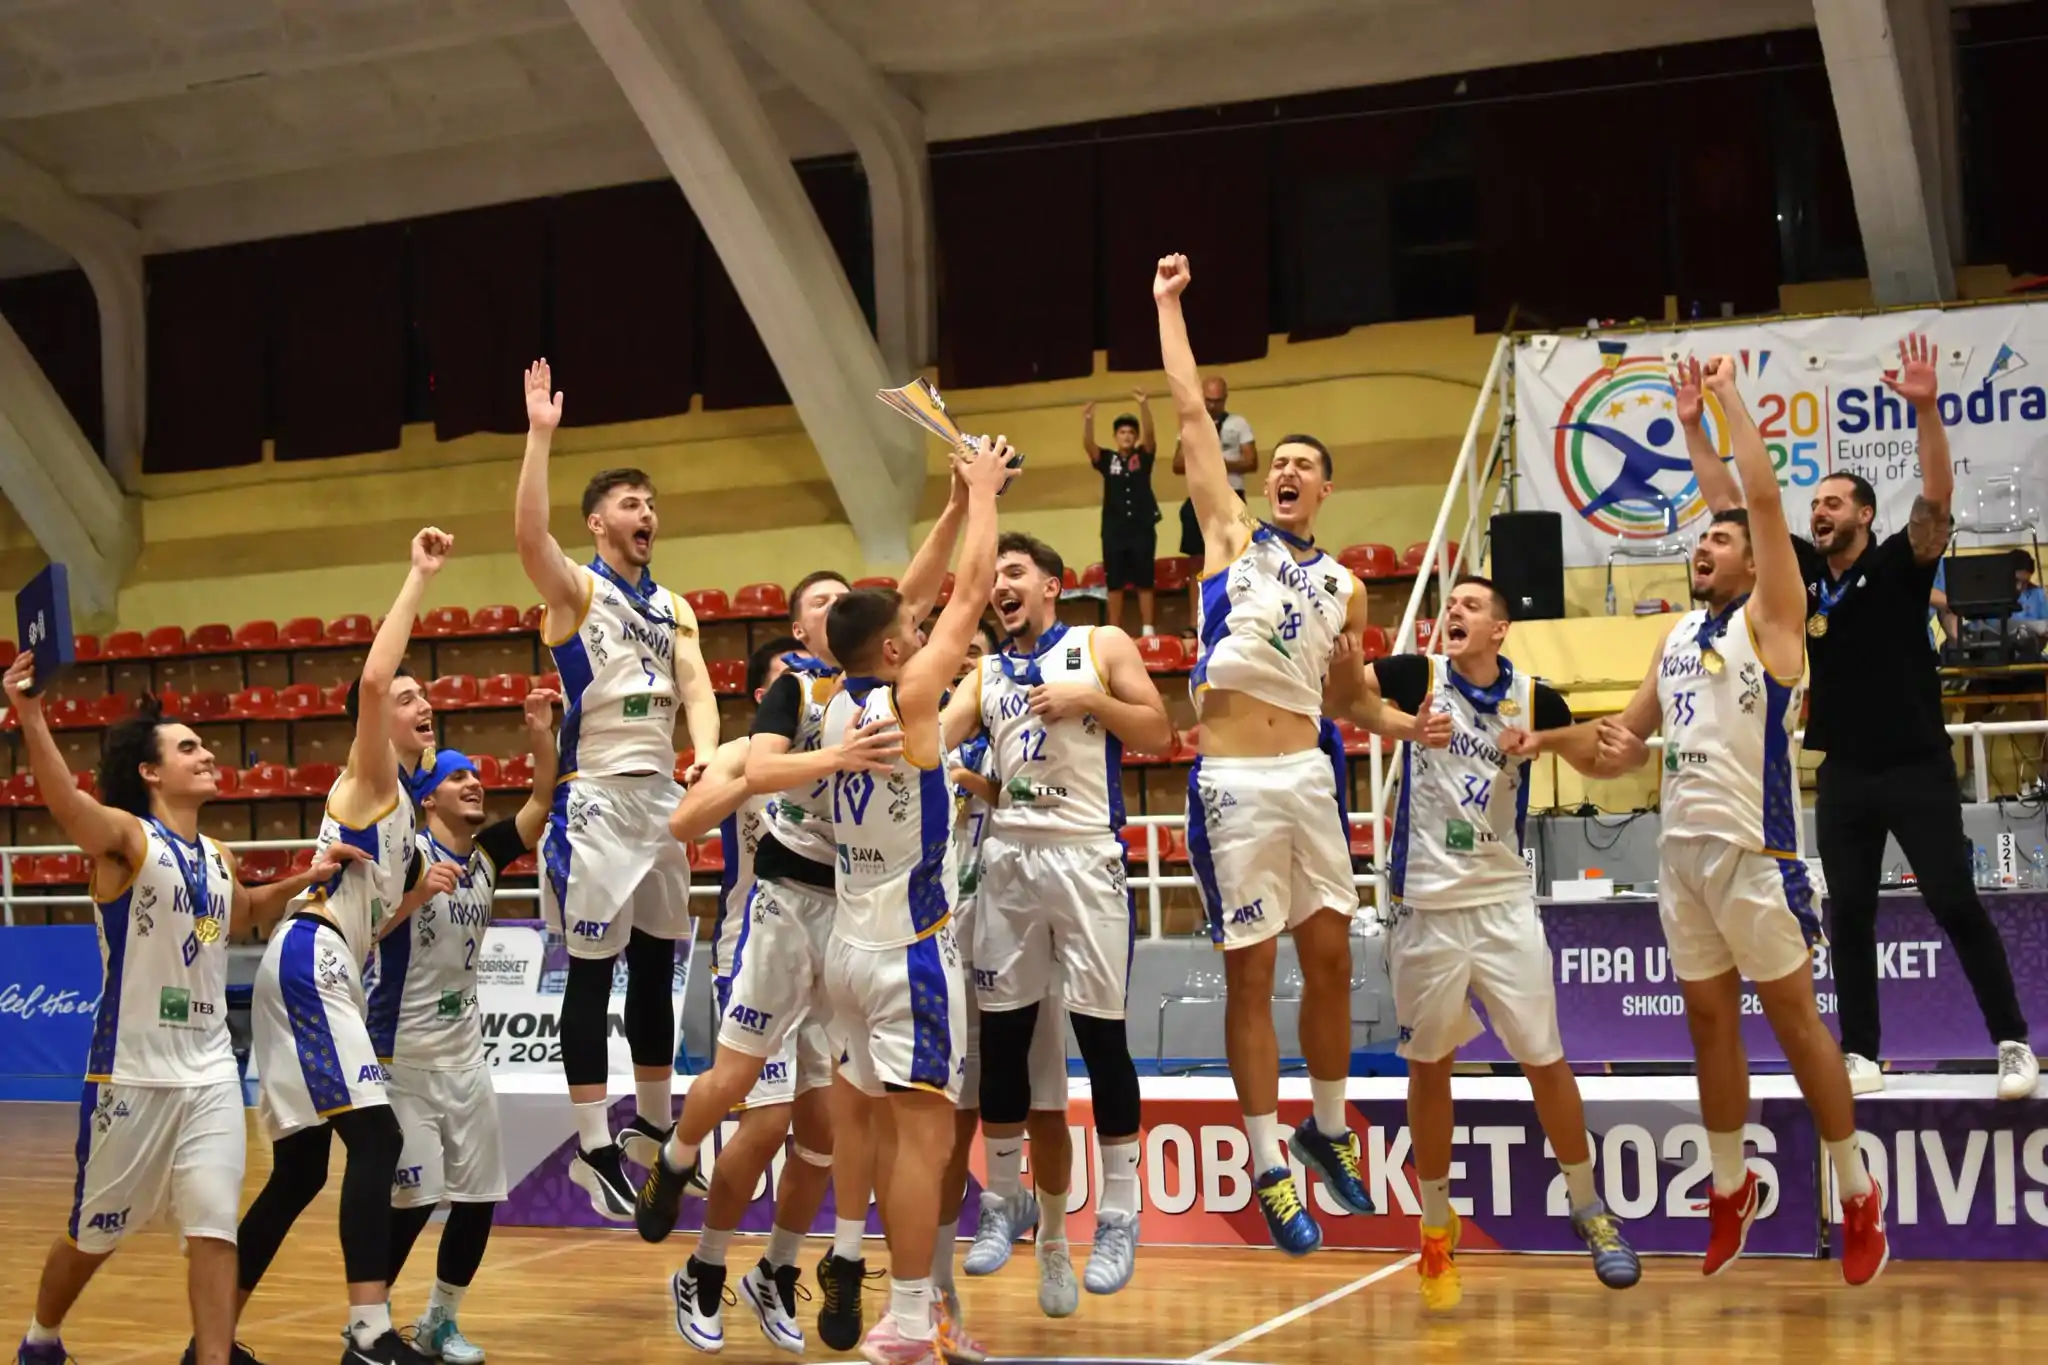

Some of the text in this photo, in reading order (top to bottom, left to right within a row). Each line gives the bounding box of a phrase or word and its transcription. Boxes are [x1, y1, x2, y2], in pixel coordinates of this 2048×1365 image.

[1758, 391, 1820, 438] 20
[1838, 439, 1920, 462] Europe
[1886, 459, 1908, 480] of
[1913, 456, 1971, 478] srt
[1277, 602, 1302, 640] 18
[641, 657, 656, 687] 5
[1661, 655, 1706, 678] KOSOV
[1673, 691, 1696, 726] 35
[1020, 729, 1048, 762] 12
[1679, 752, 1708, 763] TEB
[1036, 786, 1068, 797] TEB
[1460, 773, 1491, 812] 34
[2002, 834, 2011, 847] 3
[852, 847, 885, 863] SAVA
[2003, 848, 2011, 860] 2
[2004, 861, 2010, 873] 1
[173, 885, 226, 920] KOVA
[1231, 899, 1265, 924] ART
[573, 919, 611, 938] ART
[465, 938, 476, 971] 2
[1561, 946, 1678, 984] FIBA U
[478, 959, 529, 974] ROBASKET
[976, 969, 998, 987] RT
[191, 1001, 215, 1015] TEB
[1622, 994, 1764, 1016] SHKOD 26
[481, 1013, 627, 1039] WOMN
[729, 1004, 773, 1030] ART
[509, 1042, 562, 1063] 202
[86, 1205, 132, 1229] ART
